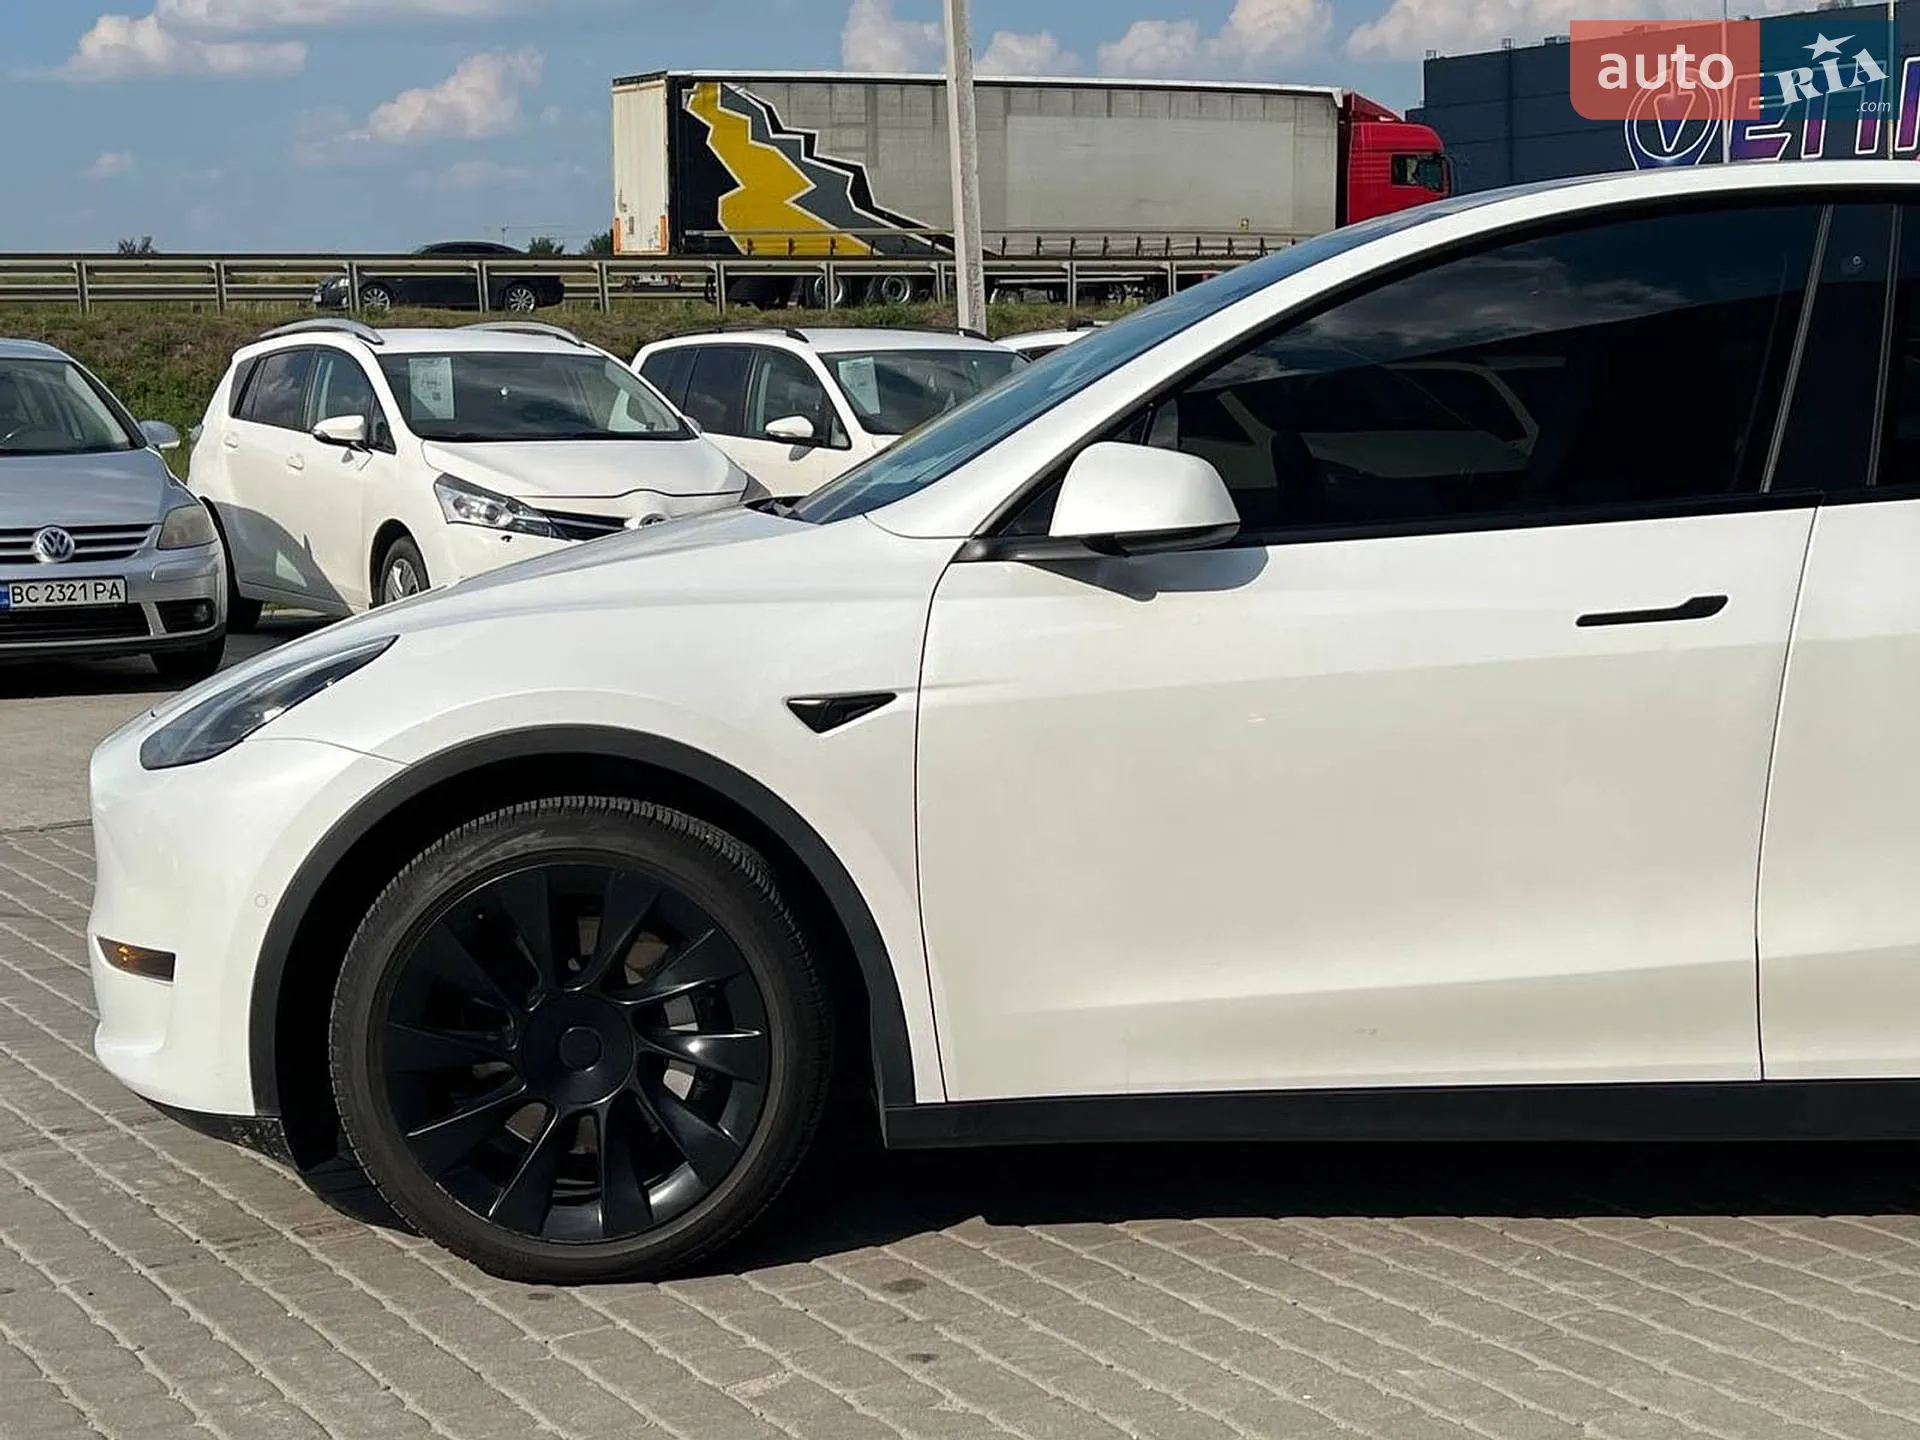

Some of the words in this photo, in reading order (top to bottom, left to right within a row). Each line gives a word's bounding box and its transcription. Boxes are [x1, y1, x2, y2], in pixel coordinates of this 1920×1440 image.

[11, 584, 39, 604] BC
[44, 583, 88, 603] 2321
[93, 582, 121, 601] PA
